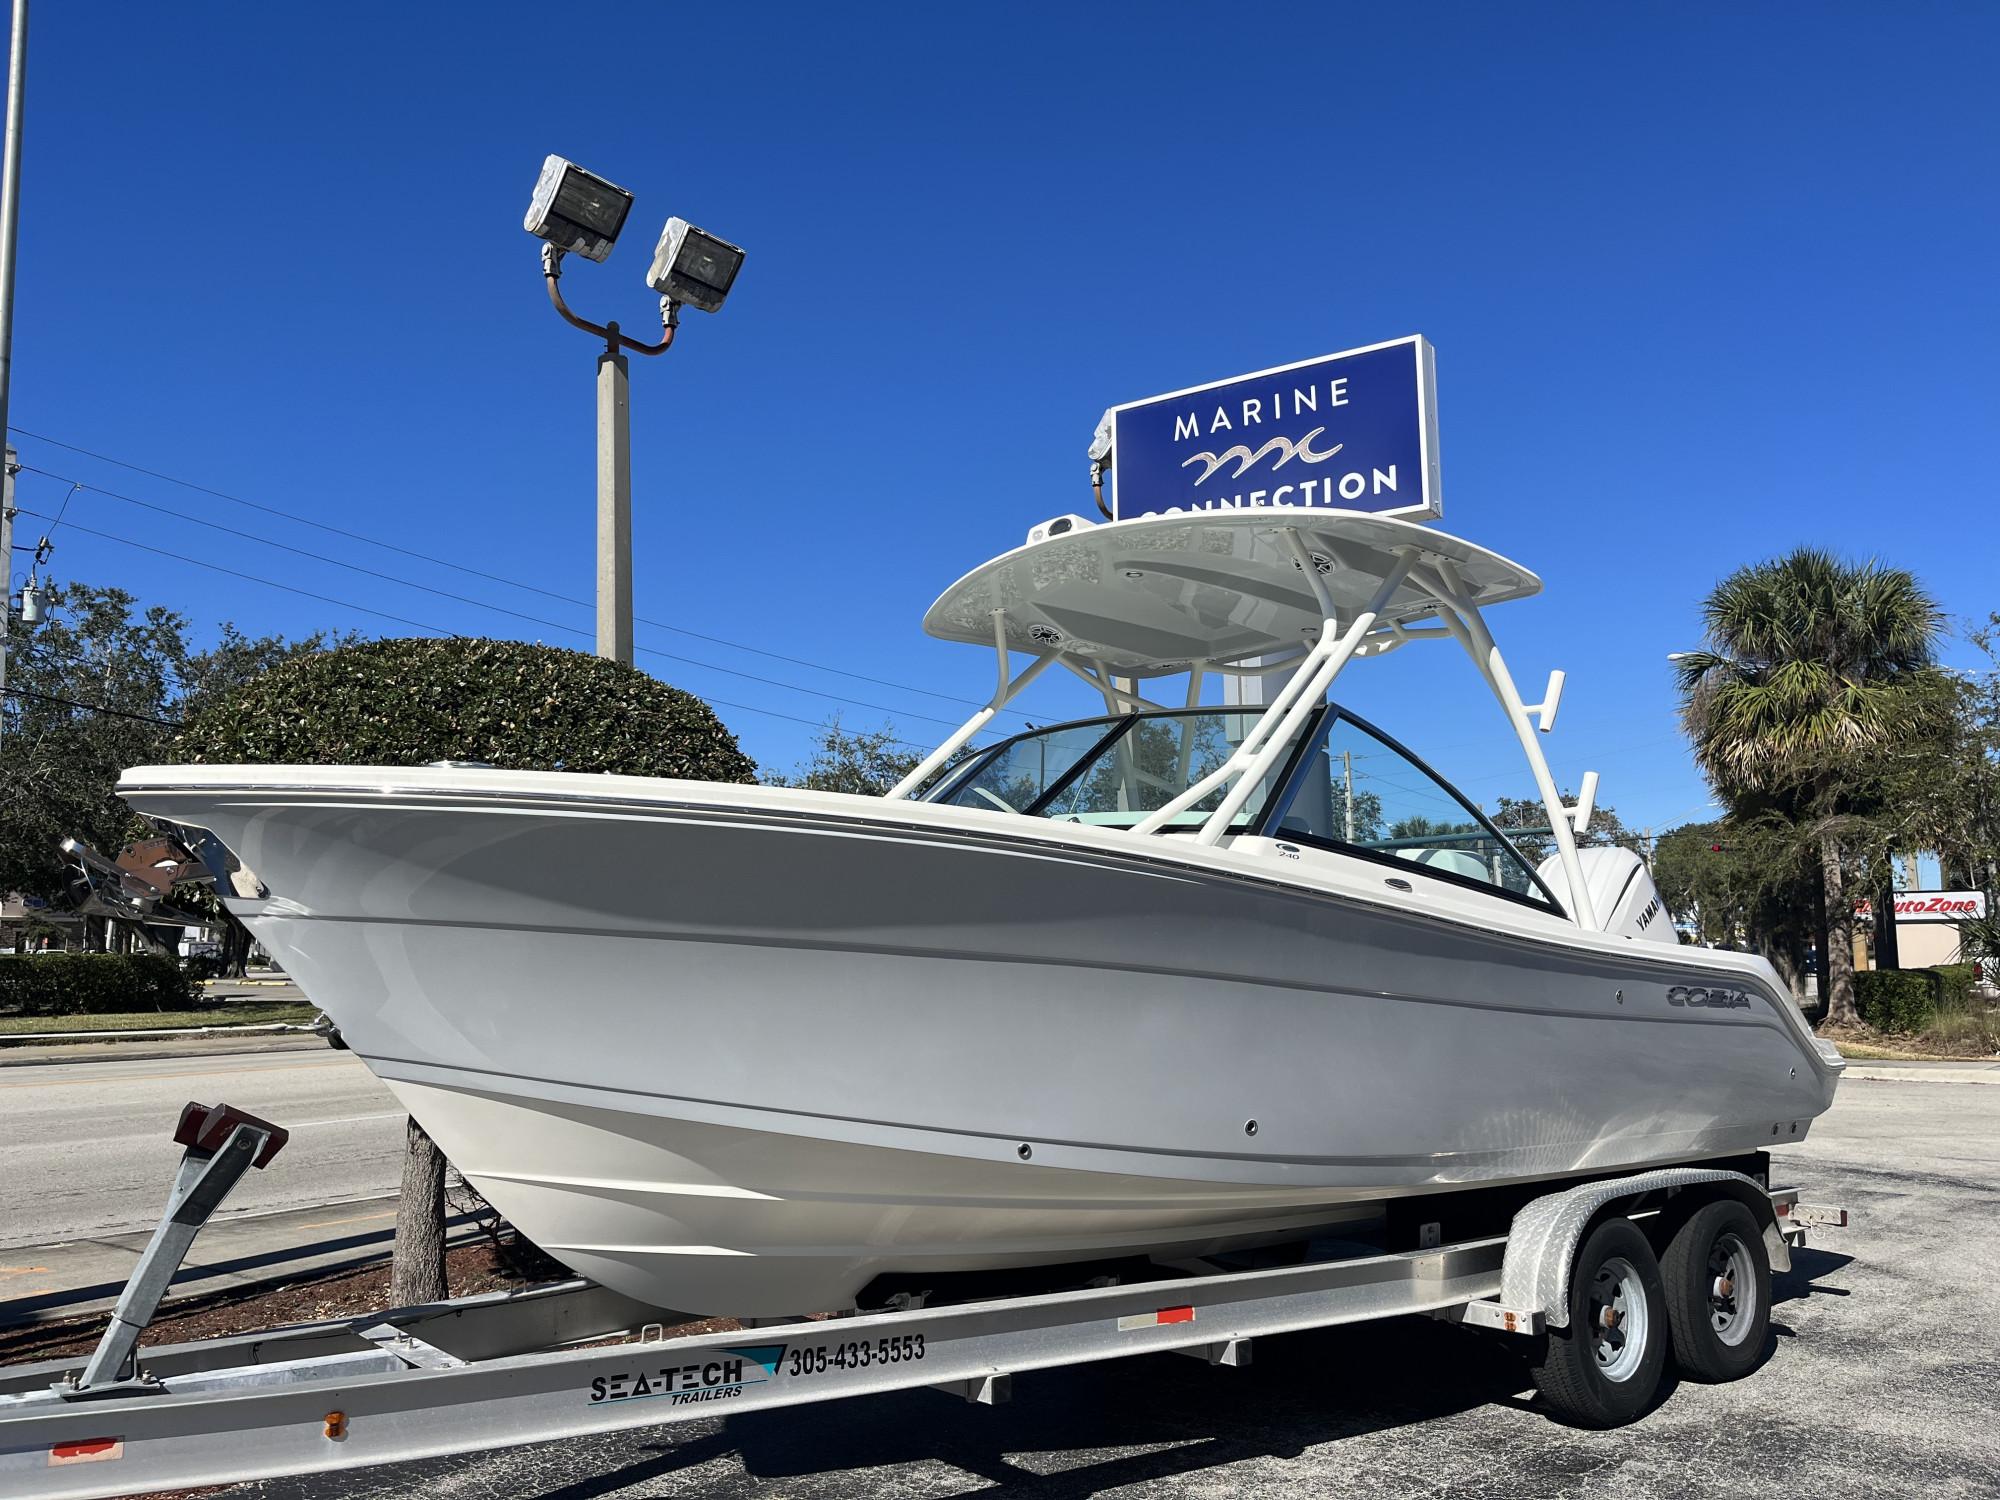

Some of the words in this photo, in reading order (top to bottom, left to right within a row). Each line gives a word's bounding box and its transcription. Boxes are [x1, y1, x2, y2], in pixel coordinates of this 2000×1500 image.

[1174, 378, 1349, 441] MARINE
[1141, 464, 1398, 518] ECTION
[1279, 851, 1300, 860] 240
[1636, 894, 1660, 931] YAMA
[1893, 897, 1978, 913] utoZone
[1666, 986, 1751, 1010] COBIA
[789, 1333, 926, 1377] 305-433-5553
[591, 1360, 743, 1402] SEA-TECH
[671, 1385, 743, 1407] TRAILERS
